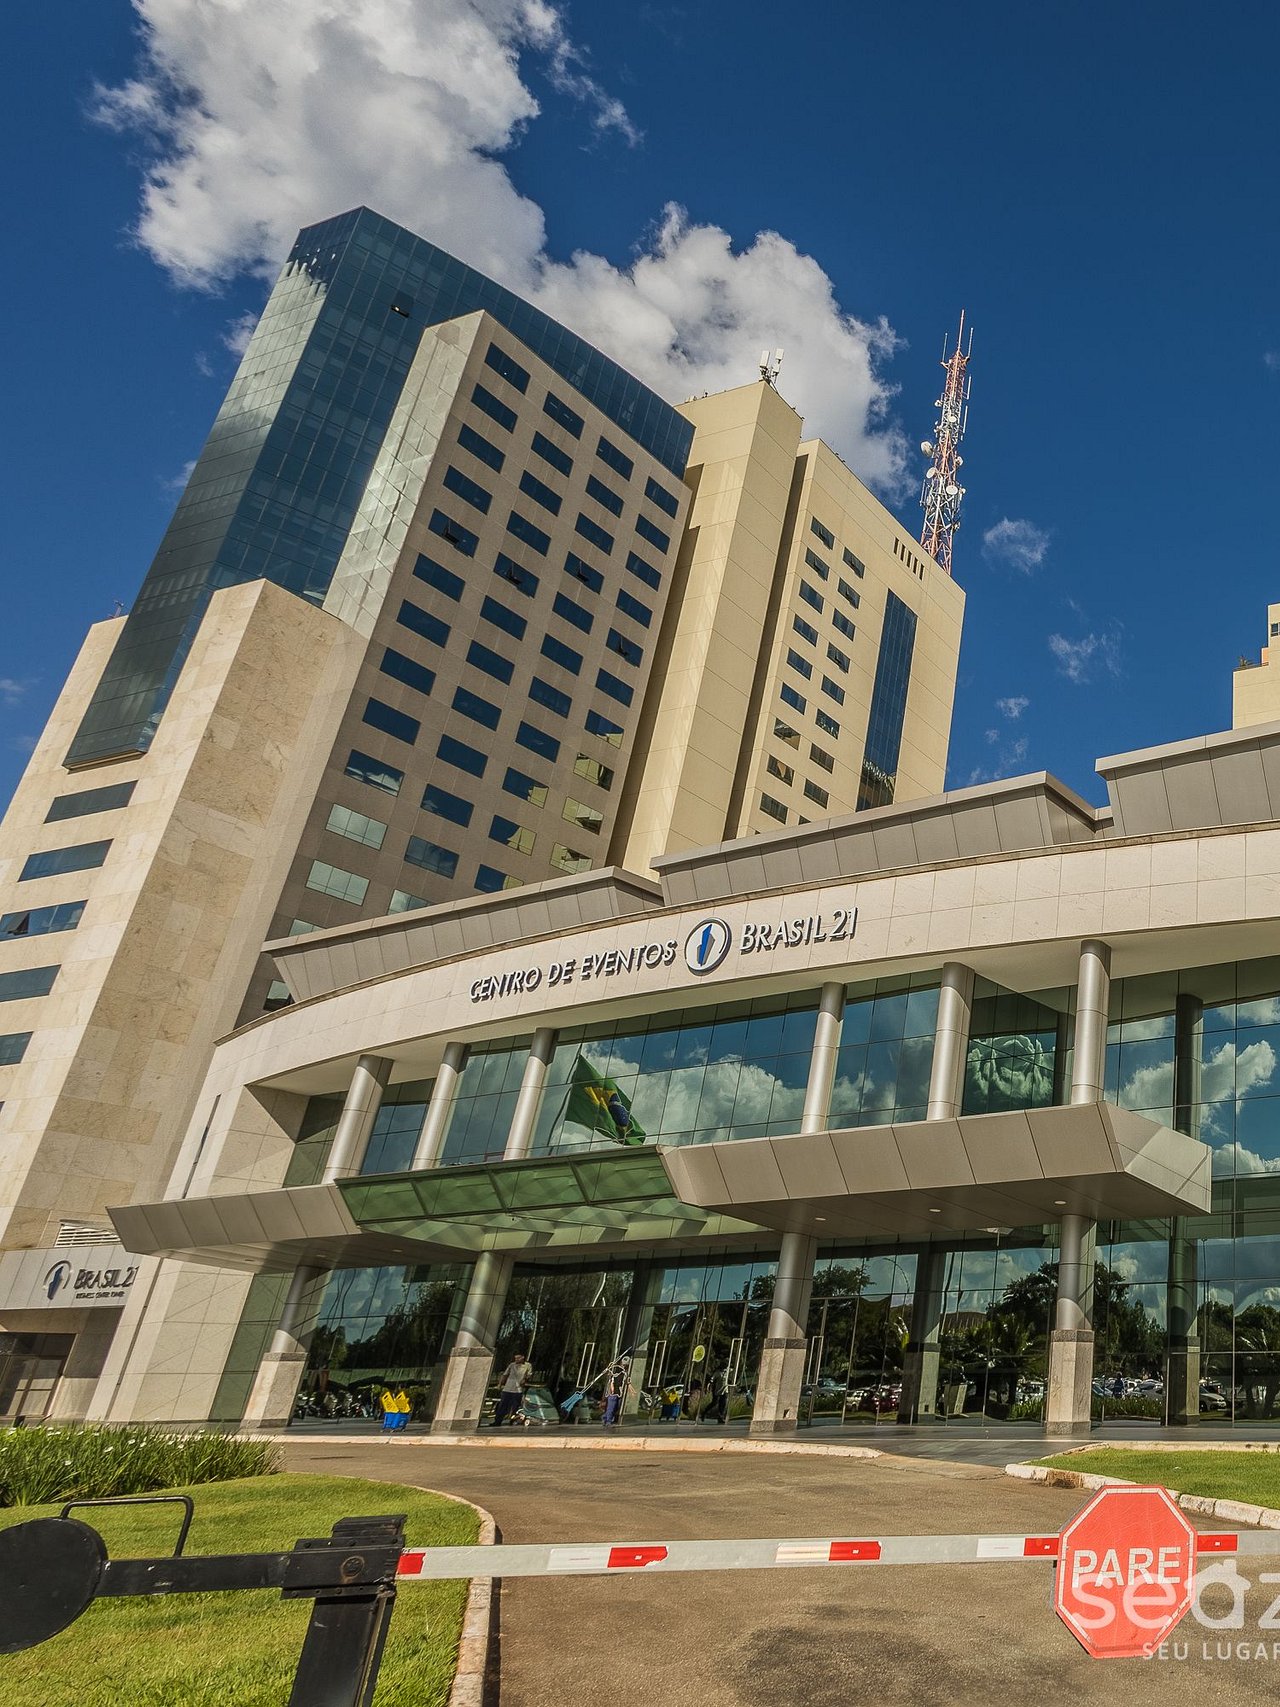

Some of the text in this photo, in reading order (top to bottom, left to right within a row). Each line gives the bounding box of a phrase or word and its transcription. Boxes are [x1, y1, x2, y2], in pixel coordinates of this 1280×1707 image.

[469, 906, 860, 1002] CENTRO DE EVENTOS BRASIL 21
[73, 1268, 123, 1290] BRASIL
[1071, 1546, 1182, 1588] PARE
